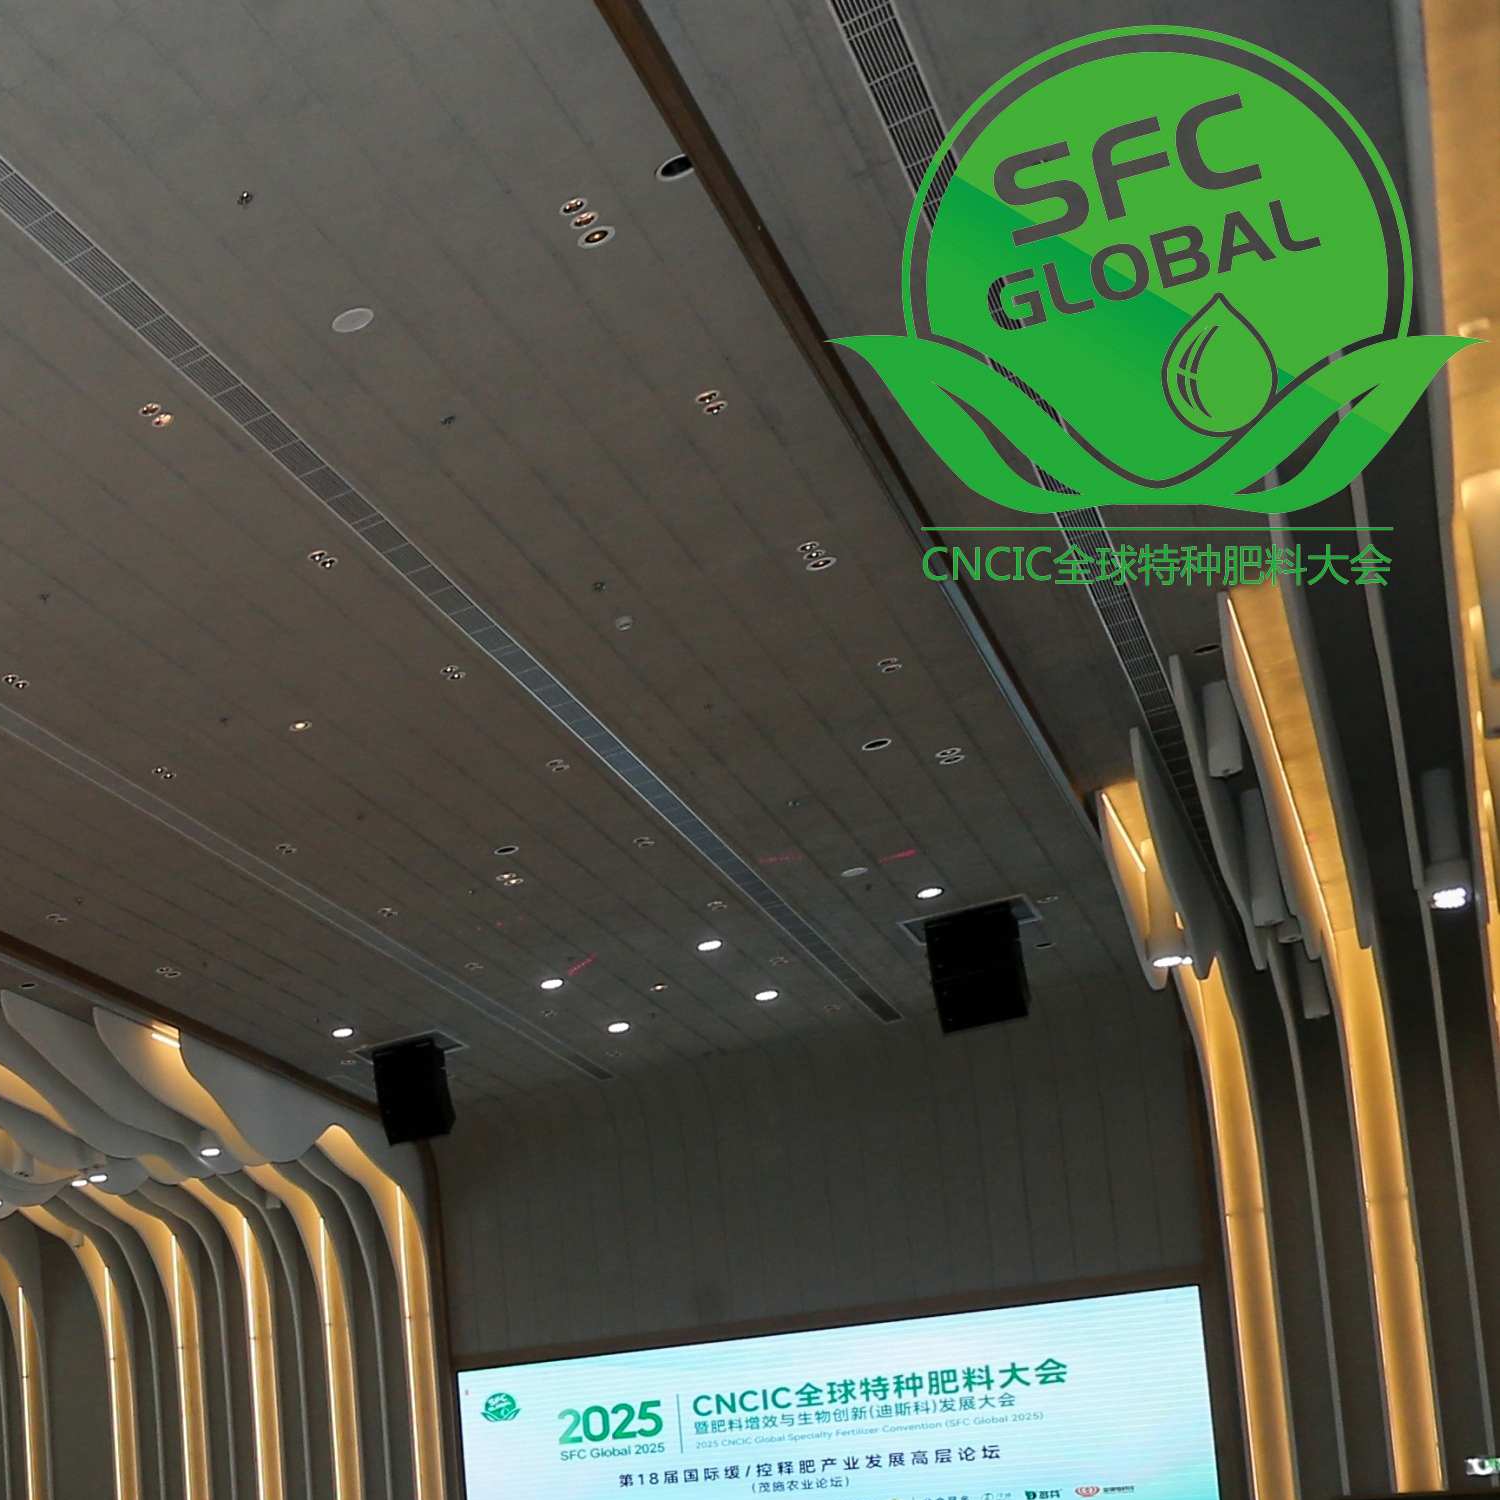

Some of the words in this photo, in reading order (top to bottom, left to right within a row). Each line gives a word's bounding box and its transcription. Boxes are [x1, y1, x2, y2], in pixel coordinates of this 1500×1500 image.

[693, 1358, 1067, 1417] CNCIC全球特种肥料大会
[557, 1400, 663, 1445] 2025
[721, 1437, 752, 1447] CNCIC
[754, 1433, 786, 1444] Global
[787, 1430, 833, 1442] Specialty
[835, 1426, 879, 1437] Fertilizer
[882, 1421, 943, 1433] Convention
[945, 1418, 970, 1429] (SFC
[973, 1414, 1009, 1425] Global
[1012, 1411, 1044, 1422] 2025)
[560, 1448, 587, 1461] SFC
[590, 1444, 632, 1459] Global
[635, 1442, 665, 1455] 2025
